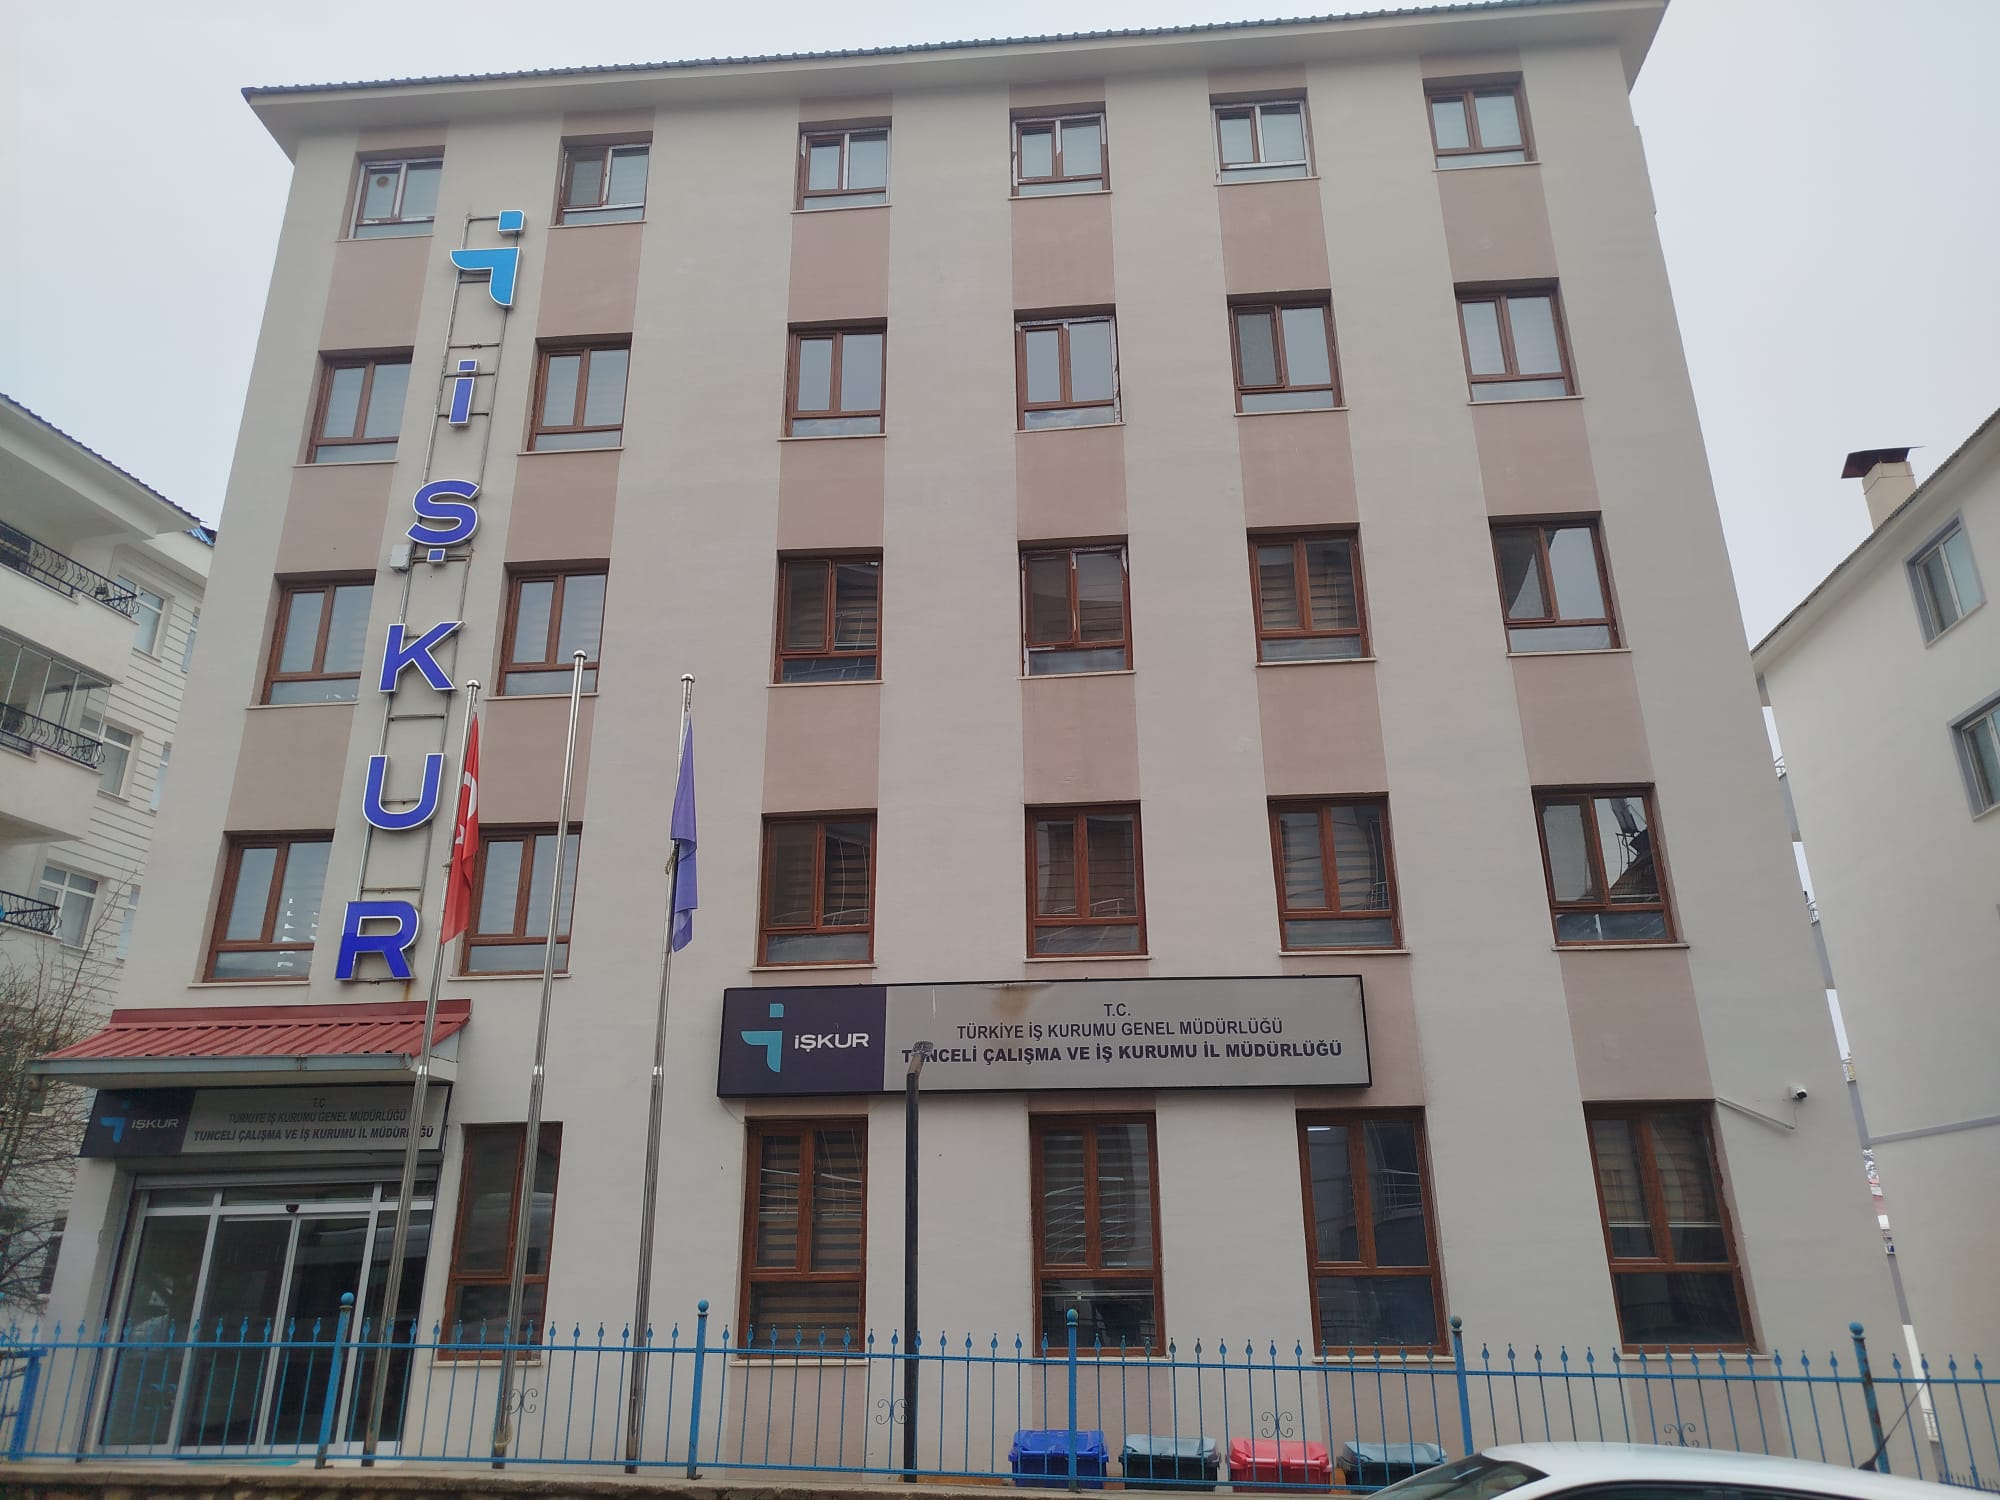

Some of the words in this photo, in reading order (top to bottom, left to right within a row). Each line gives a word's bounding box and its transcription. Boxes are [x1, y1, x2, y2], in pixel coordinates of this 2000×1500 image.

[1104, 1003, 1131, 1017] T.C.
[957, 1022, 1024, 1040] TÜRKİYE
[1028, 1021, 1043, 1042] İŞ
[1048, 1023, 1116, 1038] KURUMU
[1121, 1022, 1175, 1037] GENEL
[1179, 1017, 1283, 1035] MÜDÜRLÜĞÜ
[901, 1045, 977, 1064] TNCELİ
[983, 1046, 1062, 1065] ÇALIŞMA
[1067, 1046, 1090, 1061] VE
[1096, 1042, 1113, 1063] İŞ
[1118, 1044, 1198, 1060] KURUMU
[1203, 1041, 1220, 1058] İL
[1225, 1040, 1343, 1058] MÜDÜRLÜĞÜ
[318, 1110, 348, 1122] GENEL
[238, 1129, 282, 1143] ÇALIŞMA
[284, 1128, 299, 1140] VE
[300, 1126, 311, 1142] İŞ
[312, 1127, 356, 1140] KURUMU
[358, 1125, 368, 1139] İL
[370, 1125, 434, 1139] MÜDÜRĞÜ
